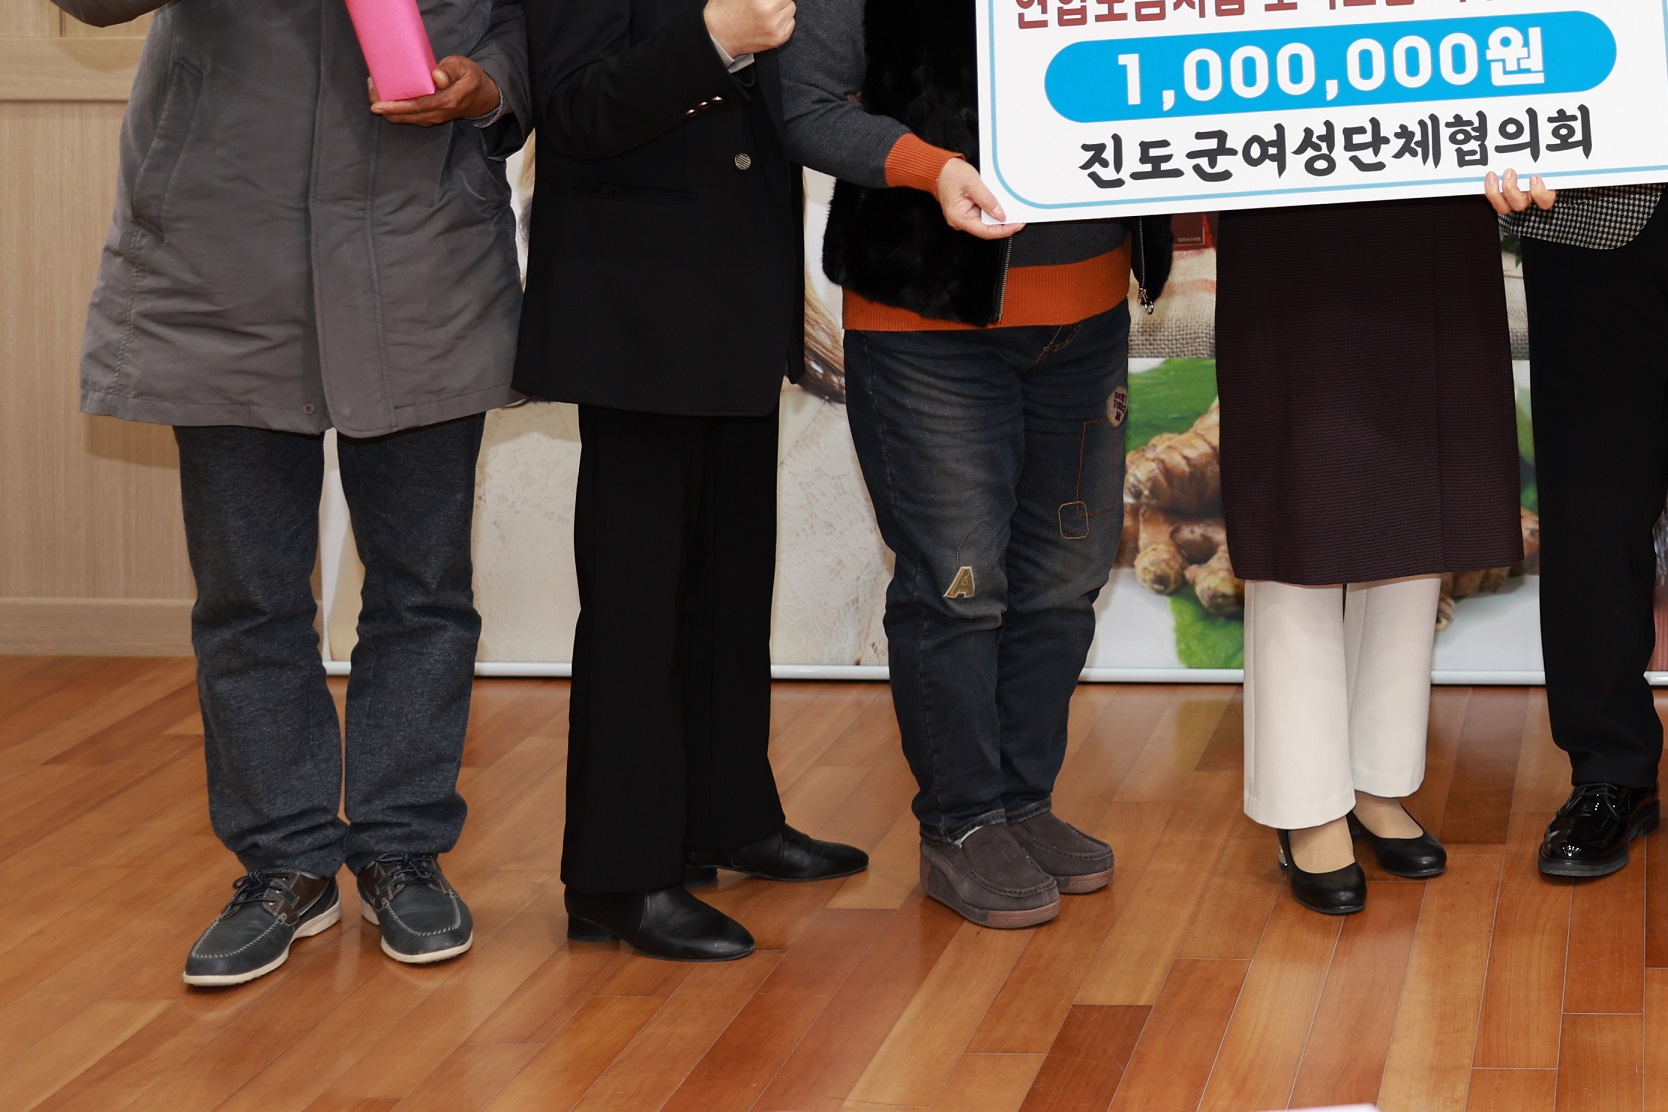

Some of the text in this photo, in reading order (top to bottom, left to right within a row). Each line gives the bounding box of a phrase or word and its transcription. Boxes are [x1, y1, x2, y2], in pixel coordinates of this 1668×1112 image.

[1116, 26, 1546, 111] 1,000,000원
[1078, 102, 1594, 190] 진도군여성단체협의회
[943, 566, 976, 598] A
